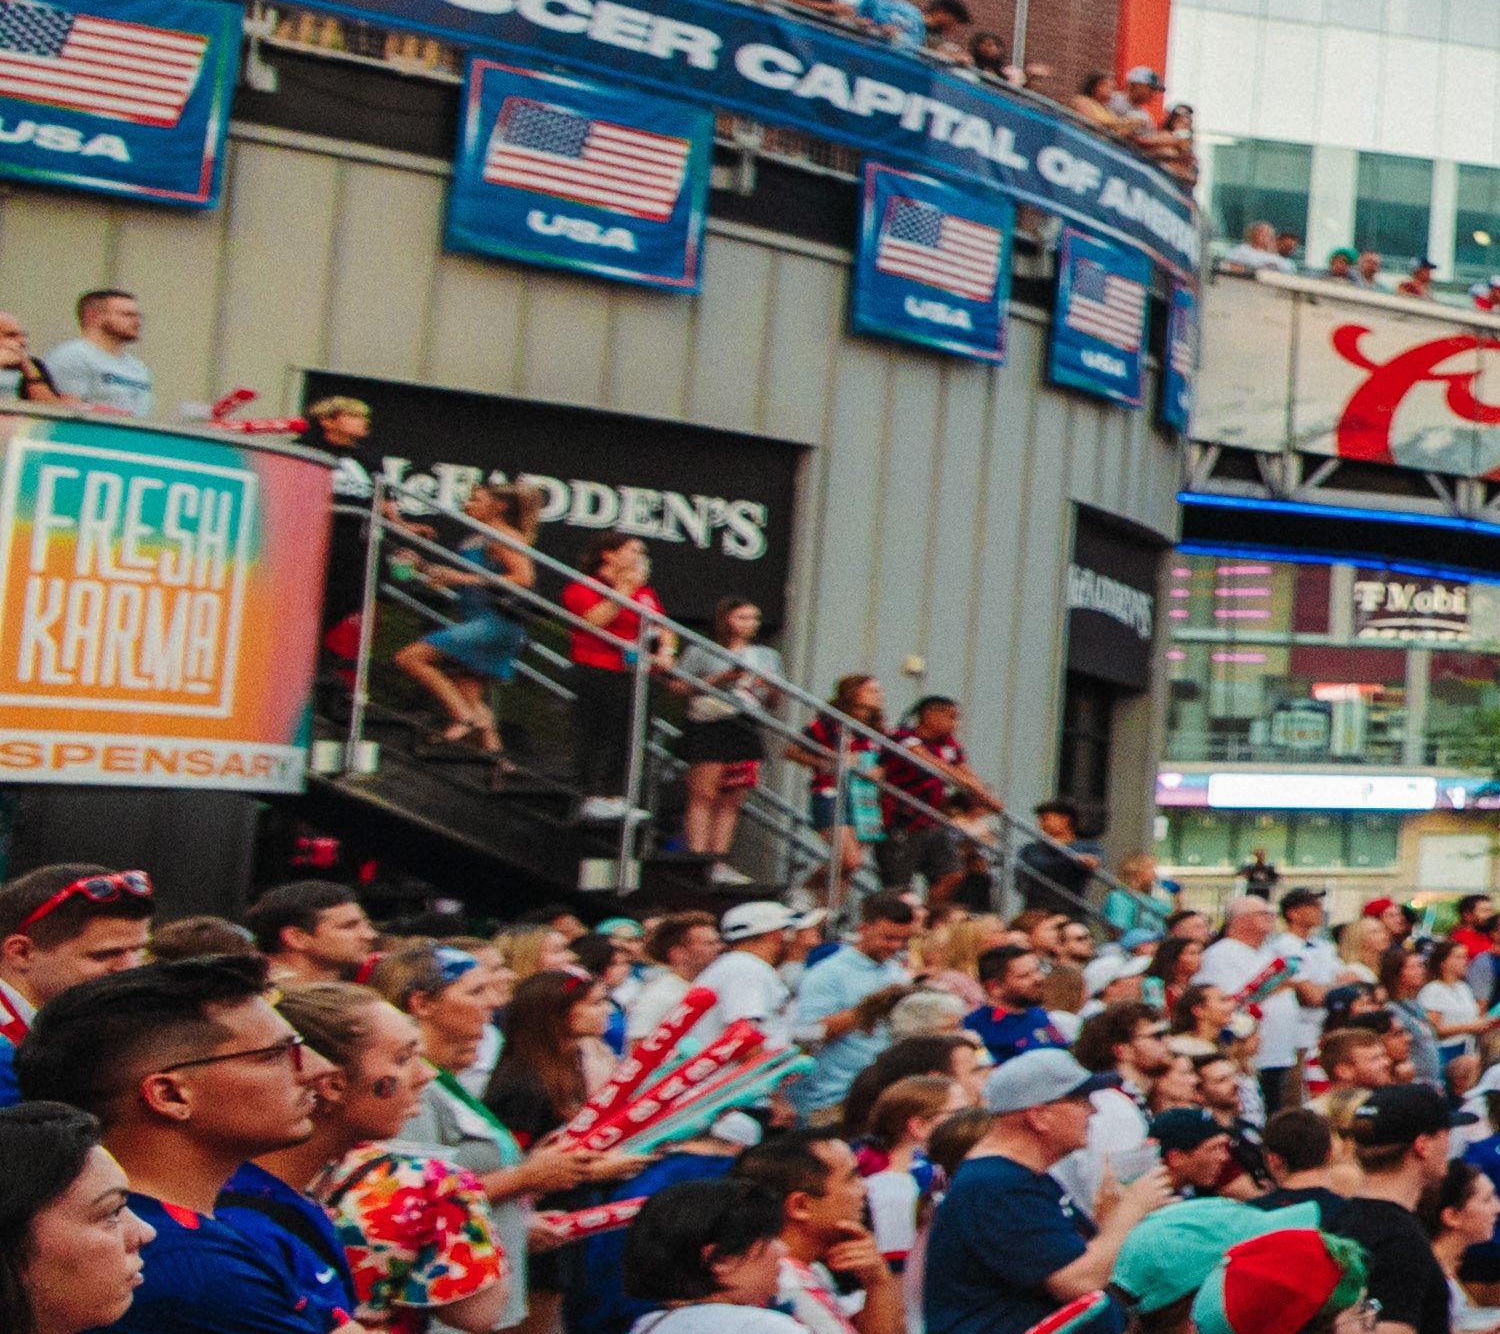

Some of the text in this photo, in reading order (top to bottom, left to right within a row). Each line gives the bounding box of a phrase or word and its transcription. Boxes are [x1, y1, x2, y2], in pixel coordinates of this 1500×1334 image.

[0, 117, 132, 163] USA
[734, 43, 1030, 170] CAPITAL
[1036, 145, 1103, 195] OF
[525, 208, 638, 254] USA
[905, 294, 974, 331] USA
[29, 464, 233, 590] FRESH
[332, 456, 768, 561] McFDDEN'S
[17, 574, 222, 695] KARMA
